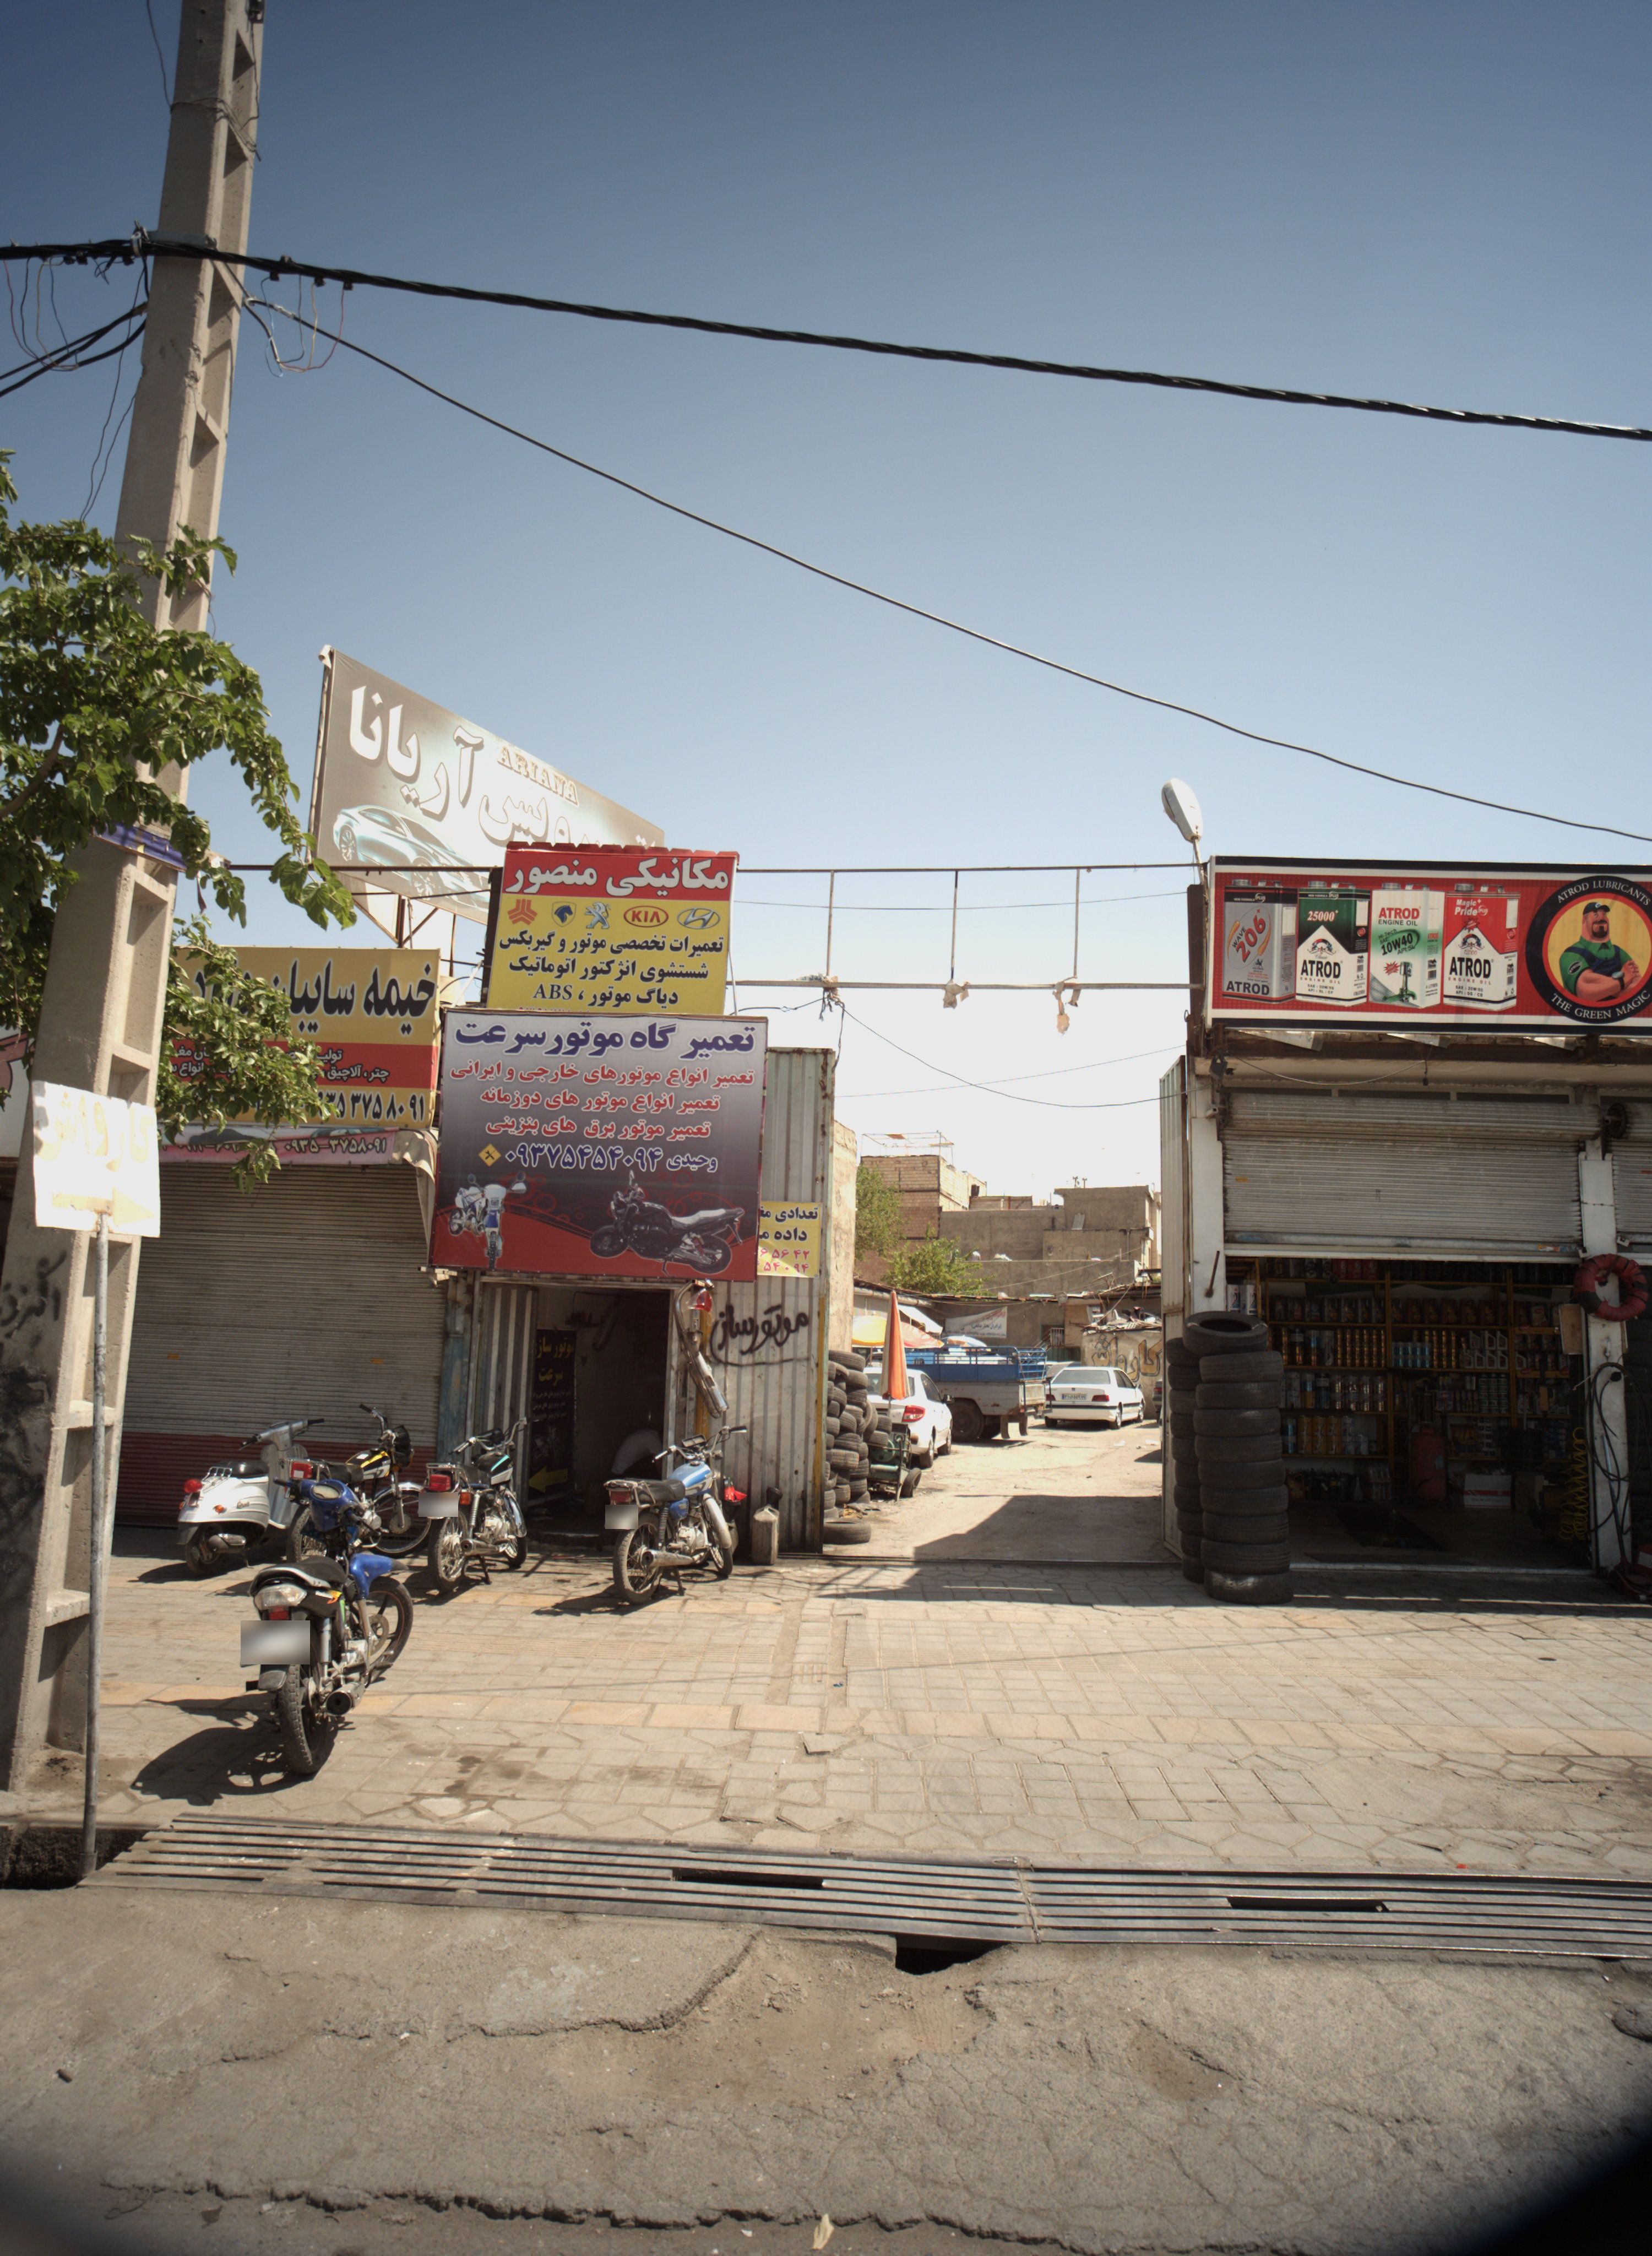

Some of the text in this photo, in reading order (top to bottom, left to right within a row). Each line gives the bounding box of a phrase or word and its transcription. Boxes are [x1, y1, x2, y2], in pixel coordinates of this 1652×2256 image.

[349, 685, 484, 822] آریانا
[497, 744, 579, 806] ARIANA
[505, 857, 729, 897] مکانیکی منصور
[1557, 880, 1651, 907] ATROD LUBRICANTS
[631, 910, 660, 923] KIA
[1378, 907, 1420, 920] ATROD
[1454, 906, 1478, 916] Pride
[499, 930, 724, 960] تعمیرات تخصصی موتور و گیربکس
[1232, 925, 1246, 949] WAVE
[1382, 932, 1414, 956] 10W40
[509, 956, 577, 976] اتوماتیک
[639, 962, 709, 983] شستشوی
[1300, 959, 1341, 979] ATROD
[1449, 956, 1492, 979] ATROD
[1226, 980, 1270, 996] ATROD
[1448, 976, 1476, 984] ENGINE
[362, 962, 437, 1036] خیمه
[532, 984, 573, 1000] ABS
[635, 986, 679, 1005] دیاگ
[1551, 989, 1651, 1020] THE GREEN MAGIC
[630, 1022, 677, 1050] گاه
[681, 1026, 757, 1059] تعمیر
[327, 1064, 362, 1080] آلاچیق
[450, 1060, 502, 1081] ایرانی
[505, 1067, 515, 1082] و
[519, 1064, 579, 1084] خارجی
[666, 1067, 708, 1087] انواع
[711, 1070, 755, 1088] تعمیر
[480, 1088, 720, 1116] تعمیر انواع موتور های دوزمانه
[485, 1114, 712, 1142] تعمیر موتور برق های بنزینی
[504, 1142, 718, 1173] وحیدی ۰۹۳۷۵۴۵۴۰۹۴
[774, 1207, 818, 1223] تعدادی
[774, 1227, 807, 1241] داده
[537, 1366, 564, 1386] سرعت
